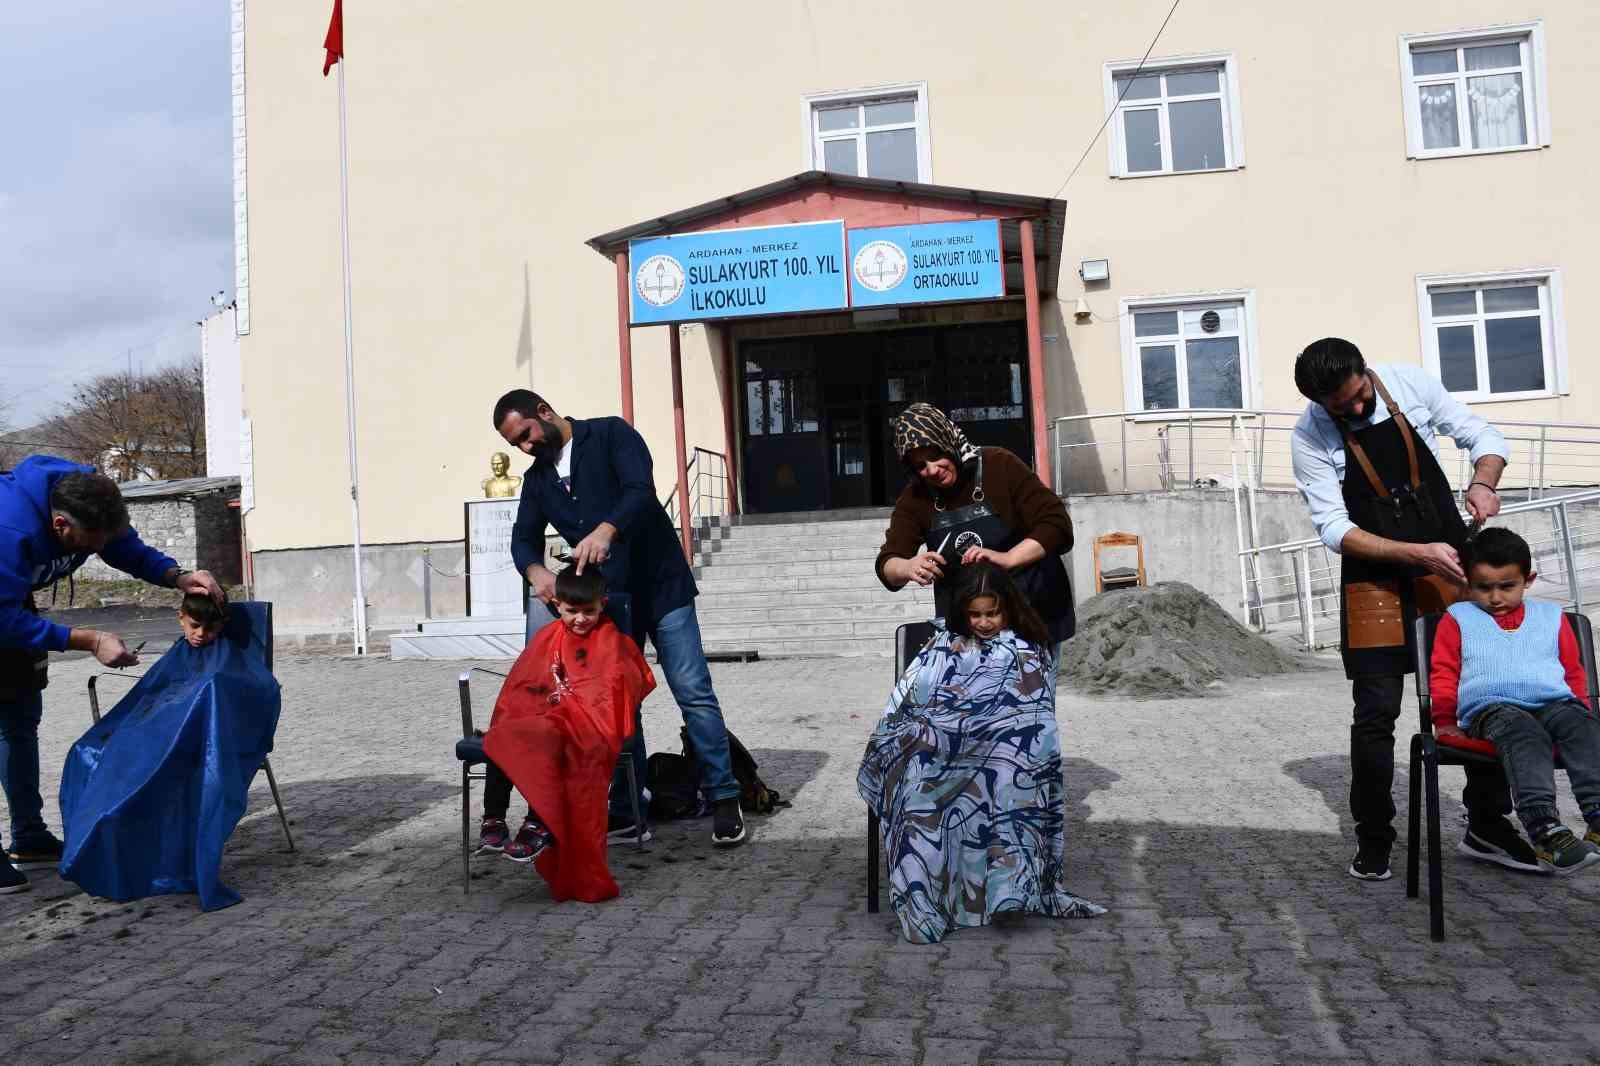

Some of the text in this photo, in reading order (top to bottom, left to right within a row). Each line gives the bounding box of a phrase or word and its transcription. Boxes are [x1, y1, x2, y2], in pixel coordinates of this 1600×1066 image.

[689, 247, 742, 259] ARDAHAN
[752, 242, 798, 253] MERKEZ
[911, 239, 942, 249] ARDAHAN
[948, 235, 973, 245] MERKEZ
[913, 249, 999, 269] SULAKYURT 100. YIL
[689, 255, 839, 285] SULAKYURT 100. YIL
[914, 271, 979, 289] ORTAOKULU
[690, 286, 766, 311] İLKOKULU
